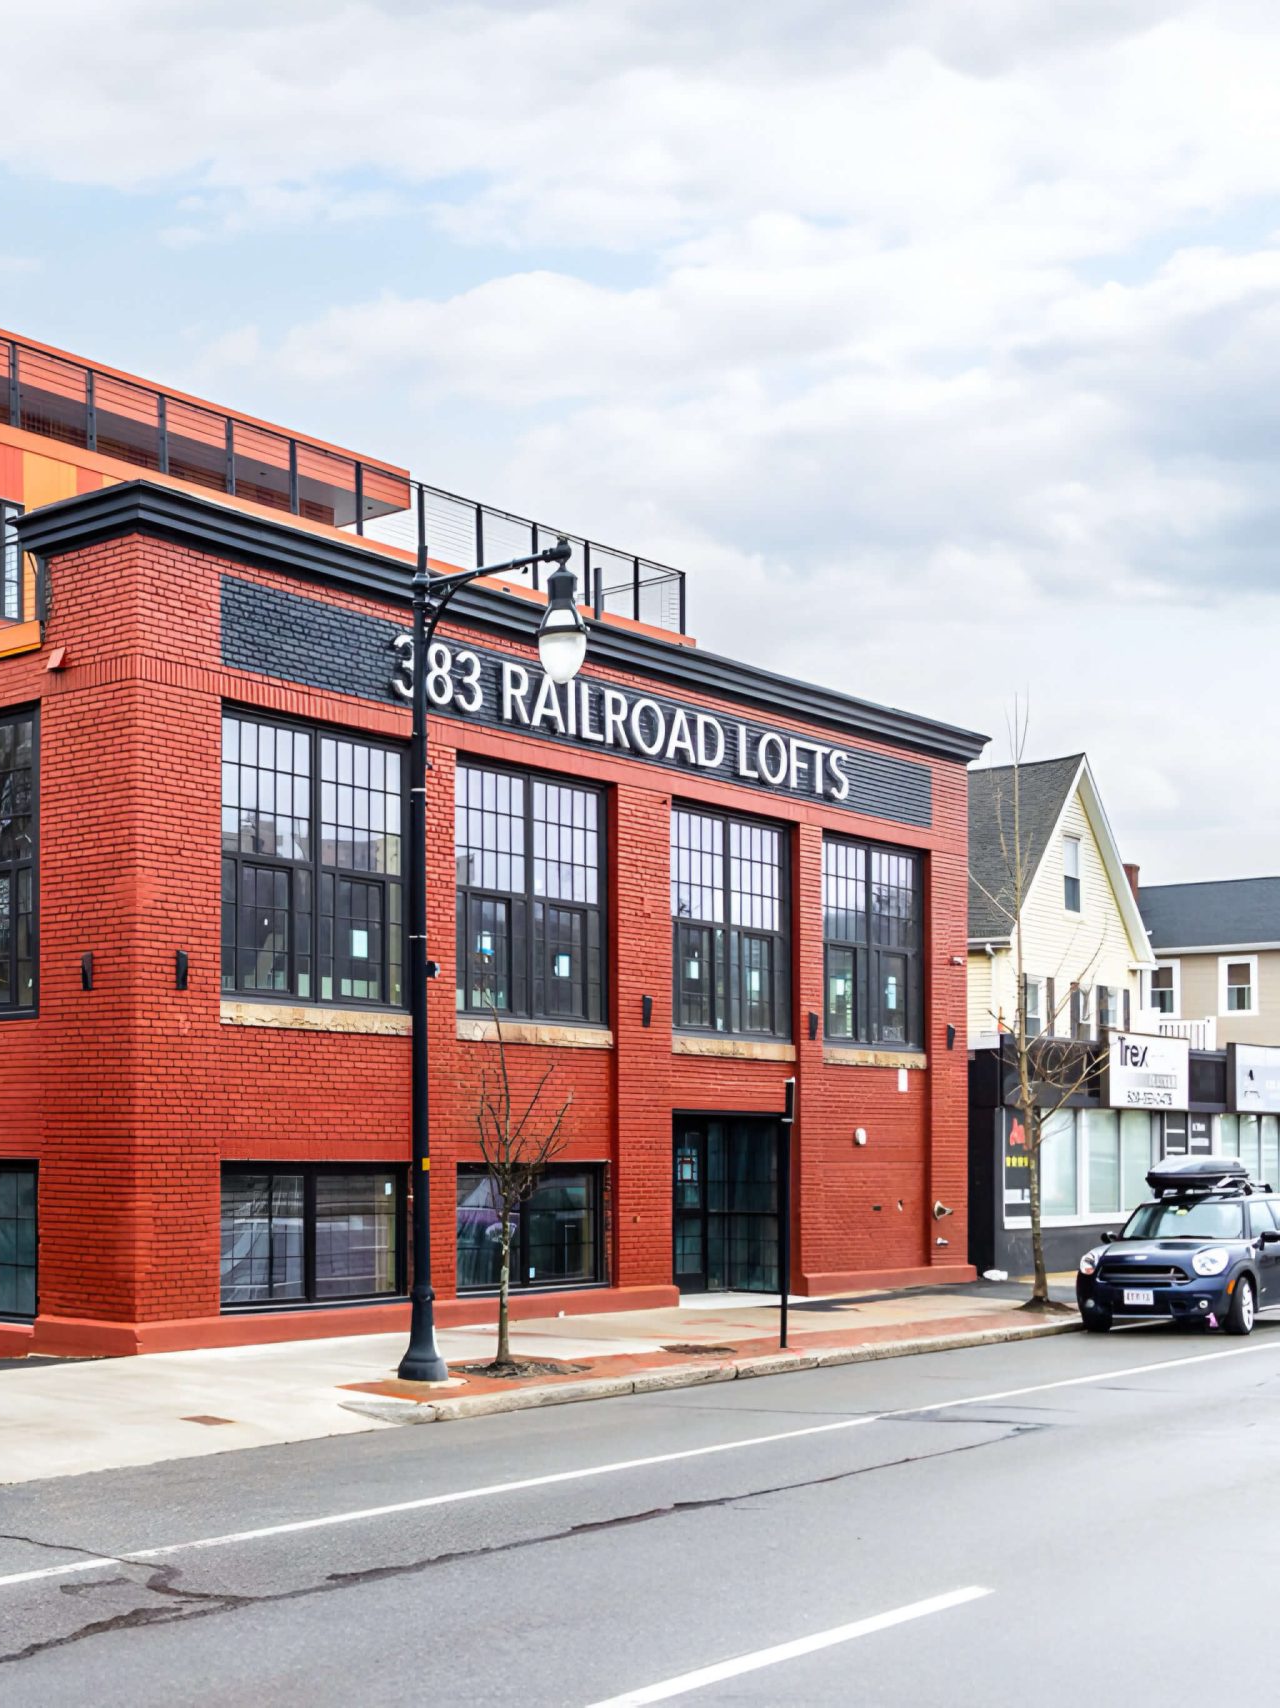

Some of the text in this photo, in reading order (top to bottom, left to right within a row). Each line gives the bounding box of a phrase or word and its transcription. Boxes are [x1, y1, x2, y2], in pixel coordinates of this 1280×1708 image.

[391, 634, 850, 800] 383 RAILROAD LOFTS
[1118, 1036, 1148, 1067] Trex
